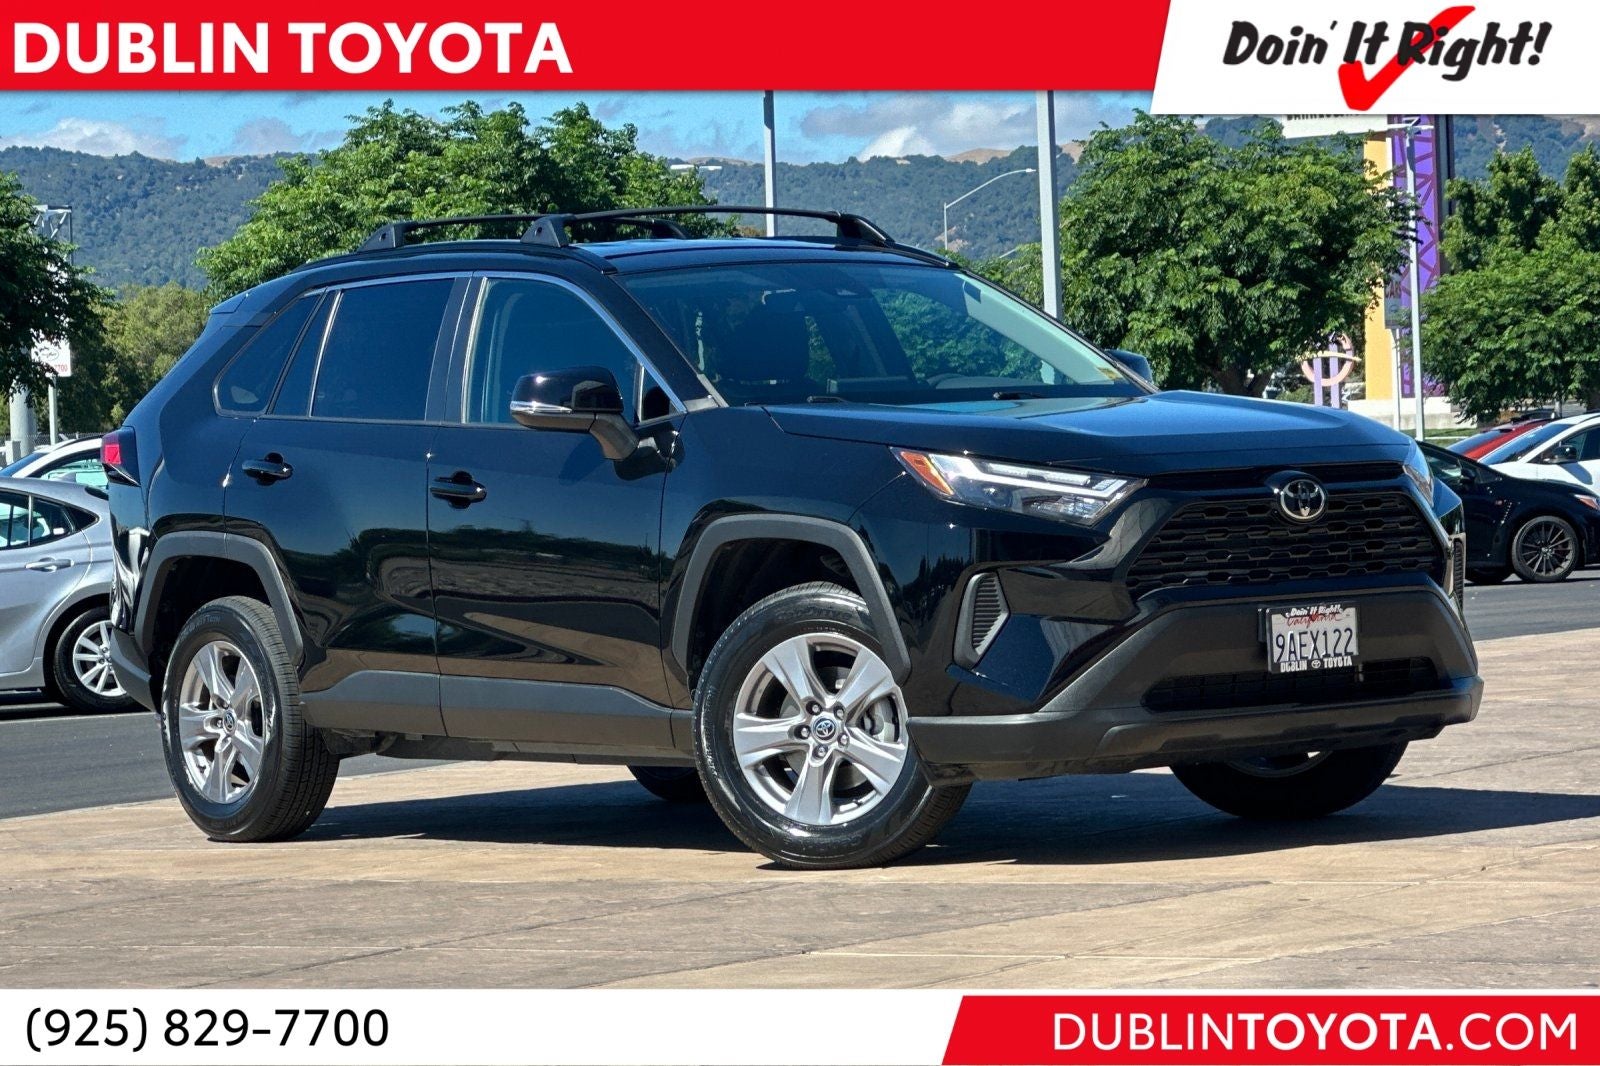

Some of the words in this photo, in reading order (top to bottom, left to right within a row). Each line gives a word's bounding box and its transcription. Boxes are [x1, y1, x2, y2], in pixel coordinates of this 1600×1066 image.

[1275, 627, 1354, 663] 9AEX122
[1280, 660, 1308, 673] DUBLIN
[1323, 656, 1353, 669] TOYOTA
